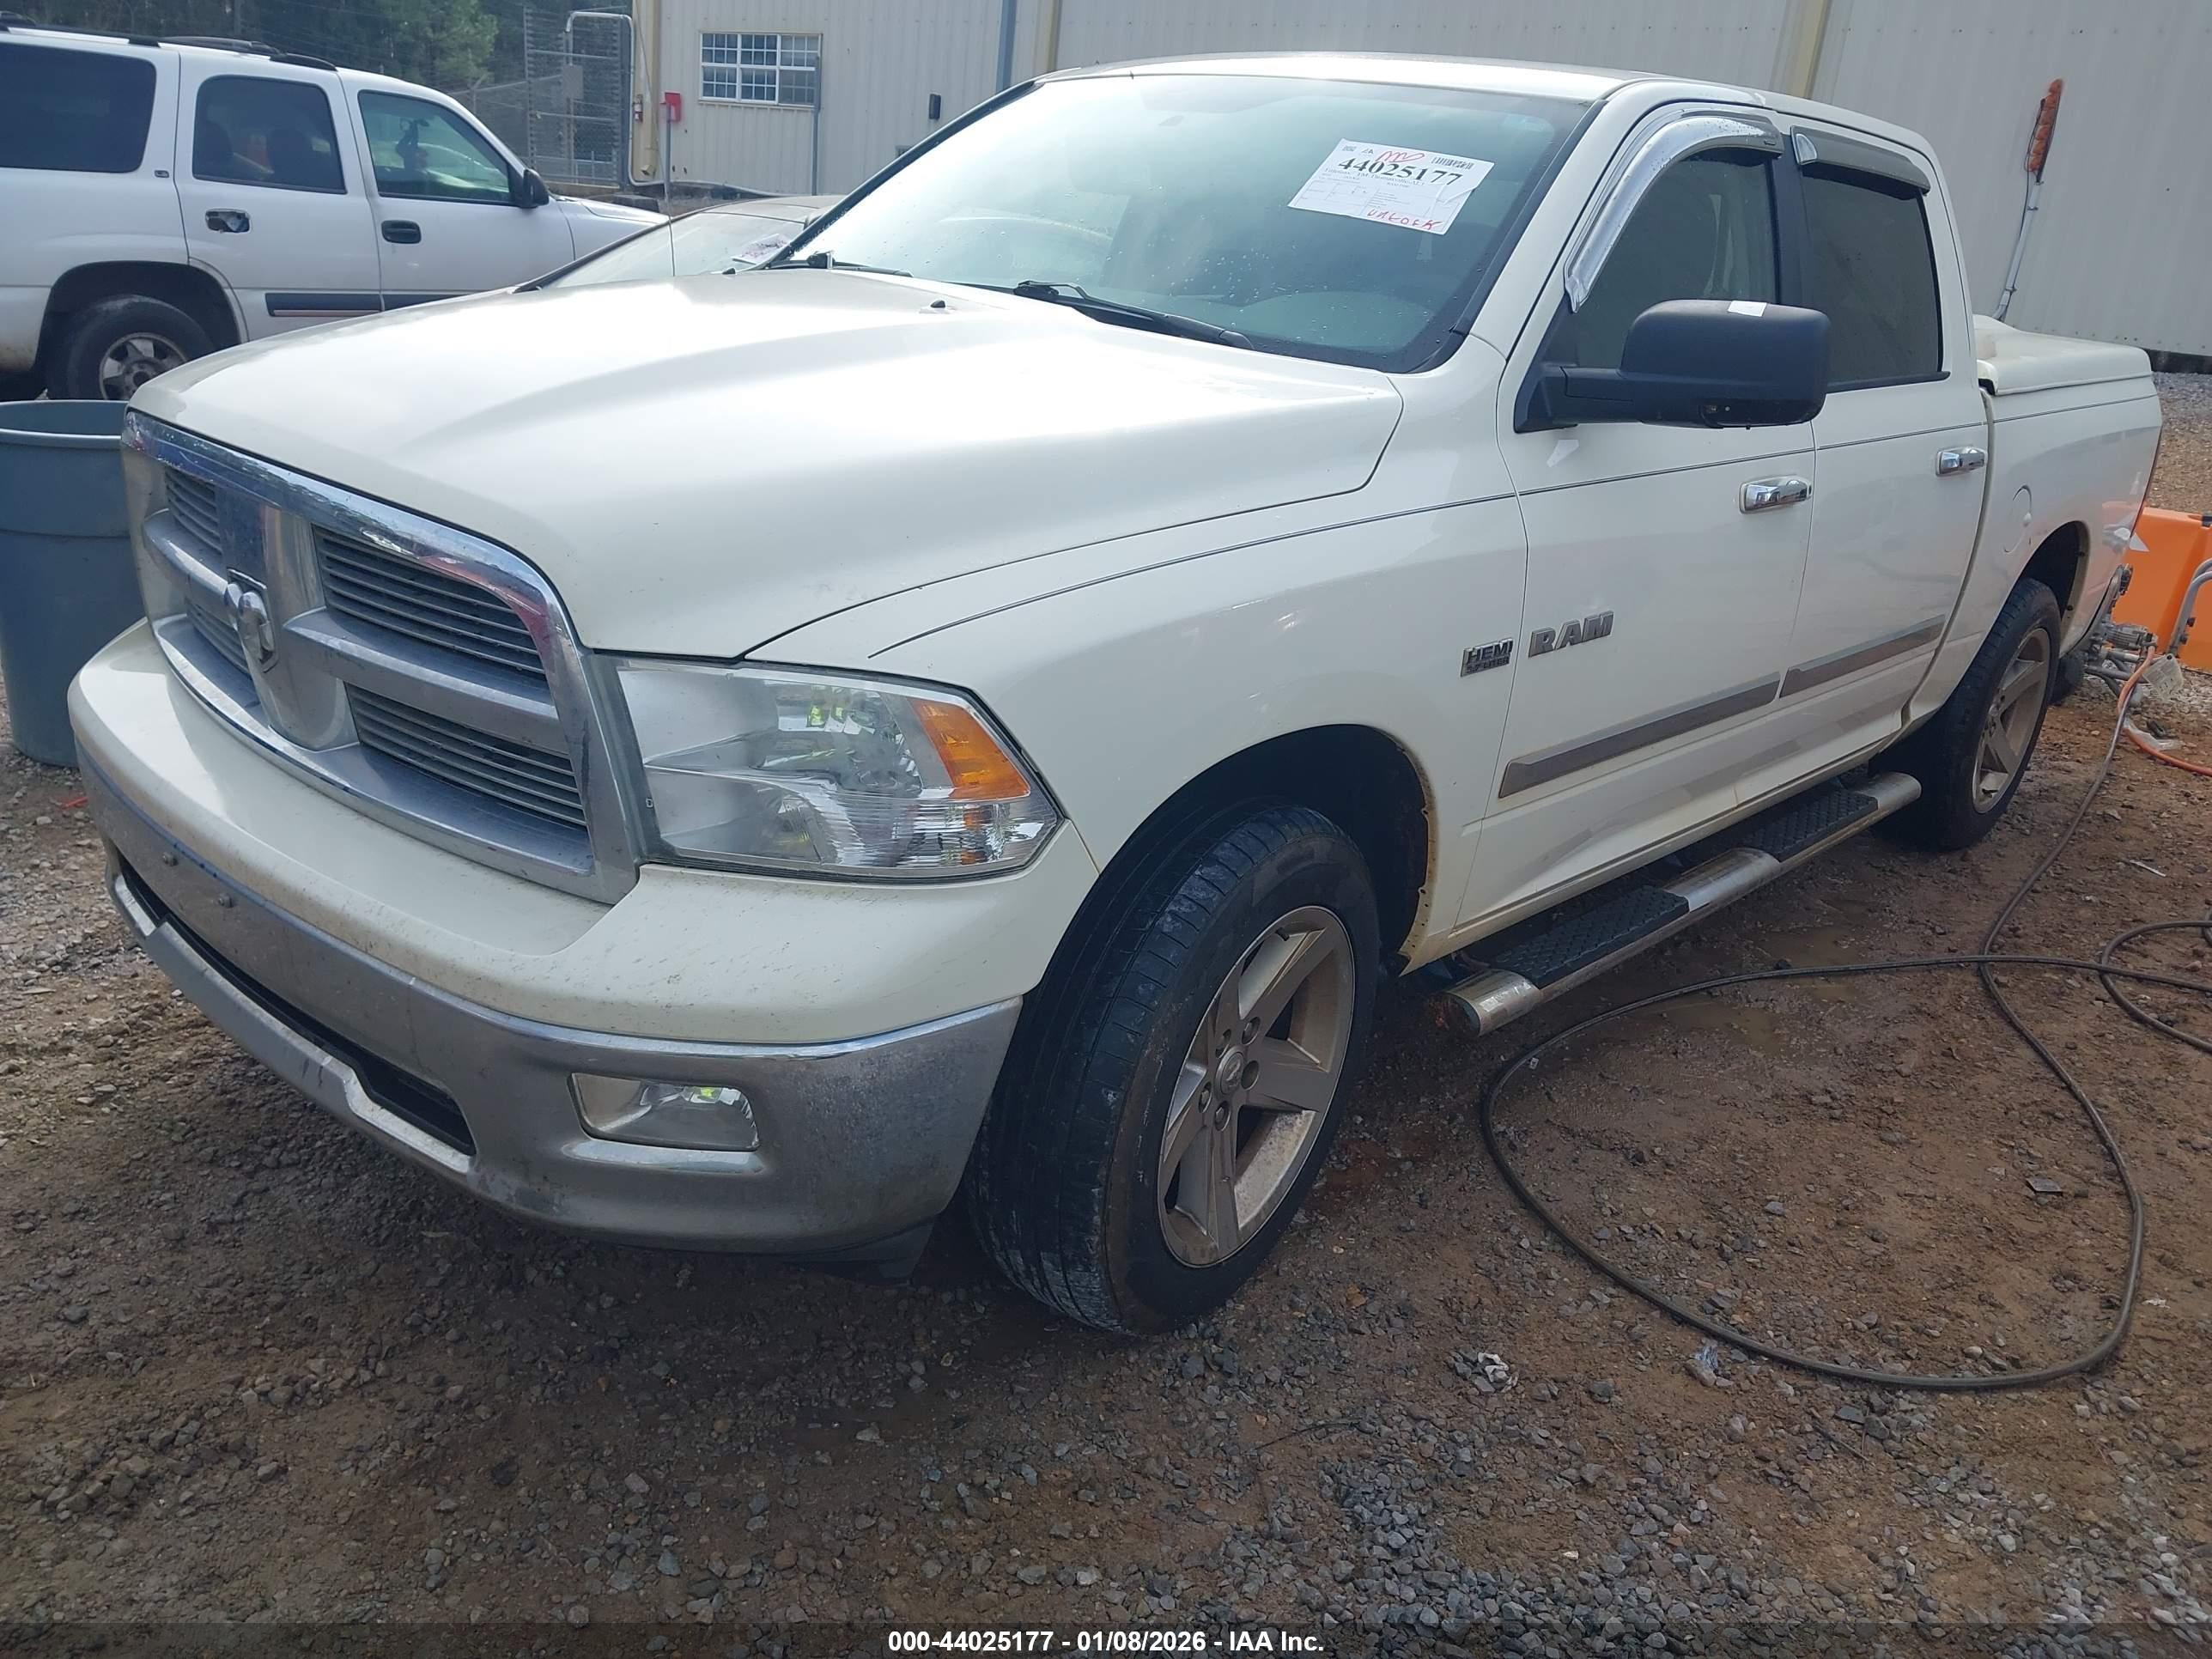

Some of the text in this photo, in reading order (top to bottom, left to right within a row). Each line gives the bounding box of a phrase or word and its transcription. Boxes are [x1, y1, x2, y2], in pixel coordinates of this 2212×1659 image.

[1337, 158, 1463, 185] 44025177
[1528, 610, 1614, 658] RAM
[1462, 638, 1514, 665] HEMI
